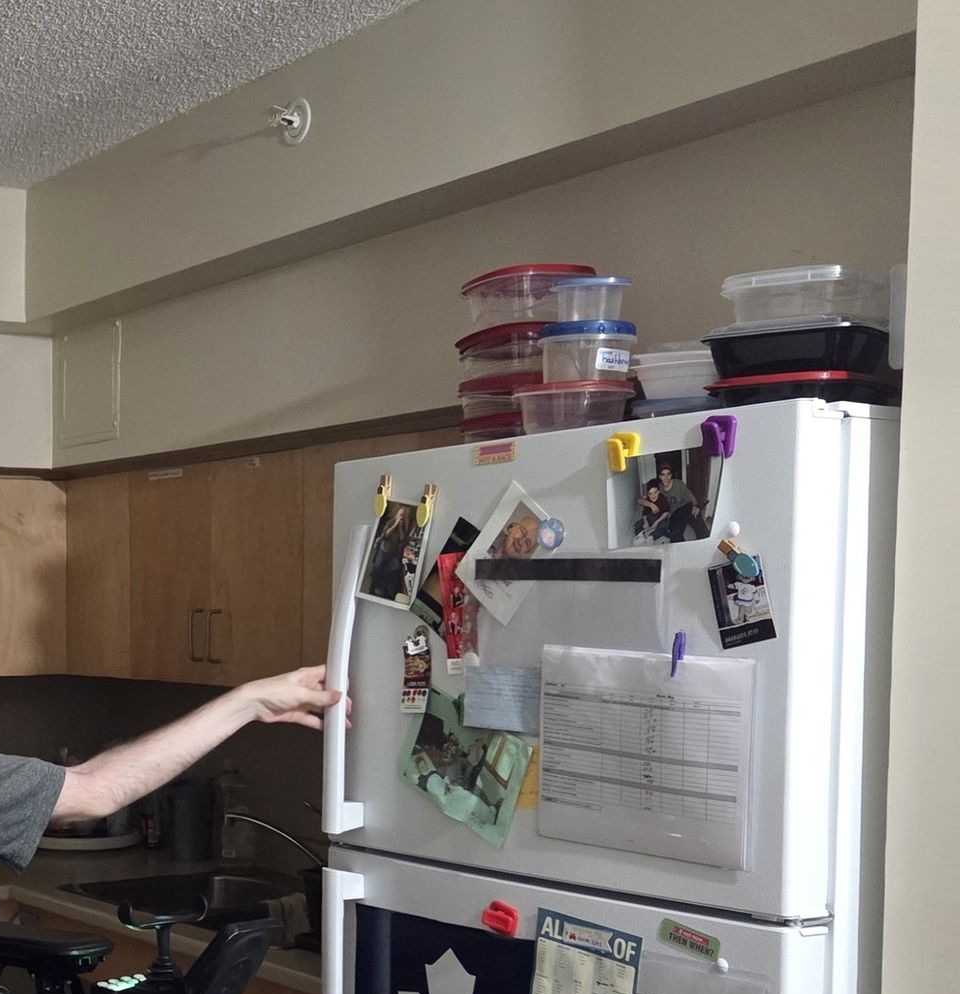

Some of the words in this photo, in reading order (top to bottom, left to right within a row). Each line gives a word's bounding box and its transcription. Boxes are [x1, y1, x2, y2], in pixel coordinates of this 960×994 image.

[613, 937, 637, 962] OF
[669, 931, 687, 947] THEN
[689, 940, 714, 958] WHEN?
